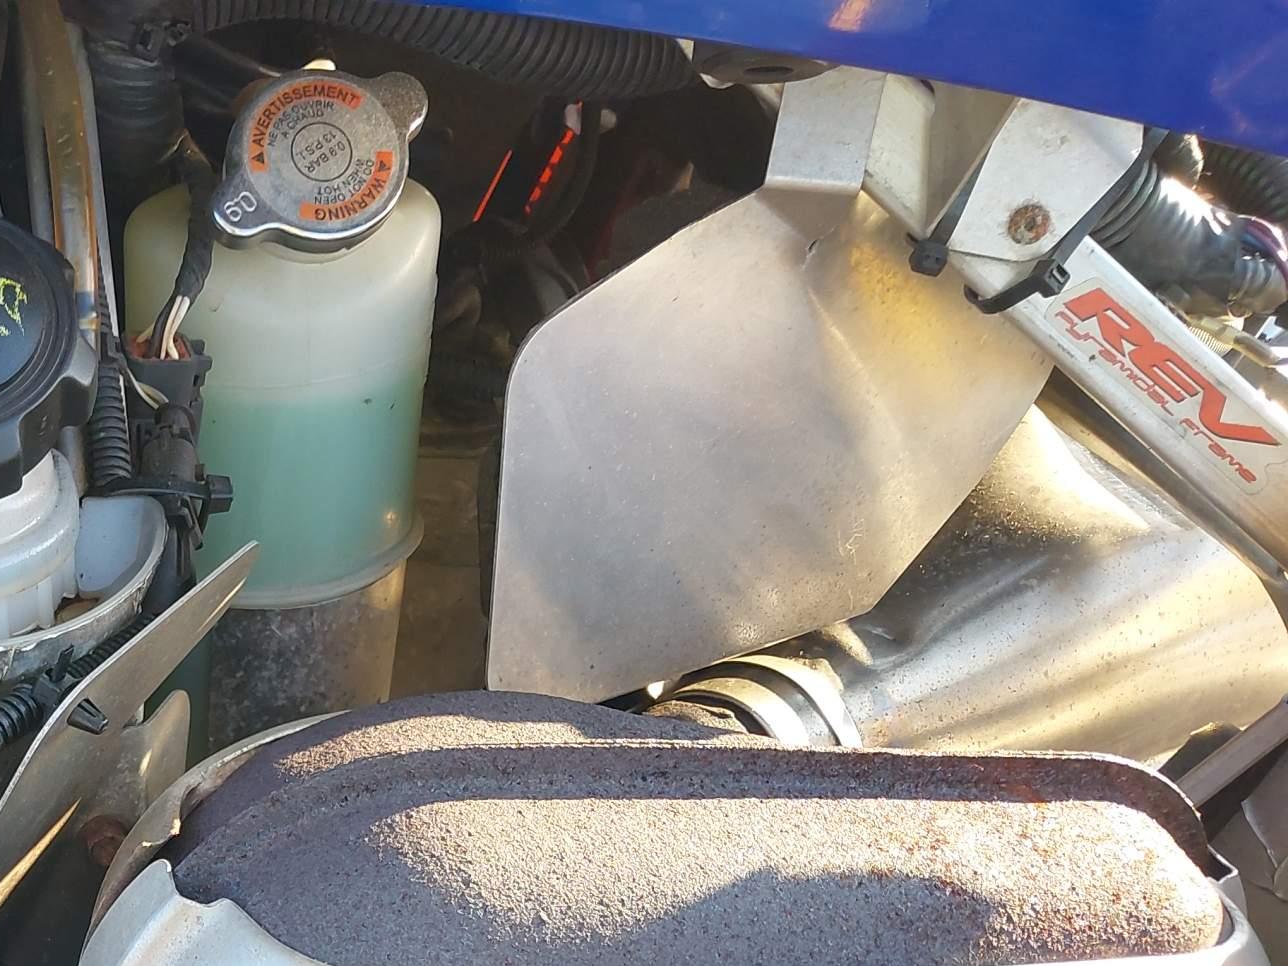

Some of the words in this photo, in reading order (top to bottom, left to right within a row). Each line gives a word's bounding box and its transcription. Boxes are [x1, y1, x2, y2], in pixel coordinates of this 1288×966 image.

[252, 84, 360, 147] AVERTISSEMENT
[286, 107, 325, 131] CHAUD
[323, 131, 337, 144] 13
[304, 152, 330, 173] BAR
[342, 158, 365, 189] WHEN
[362, 159, 375, 177] DO
[317, 183, 342, 196] HOT
[348, 175, 368, 198] NOT
[314, 192, 347, 205] OPEN
[314, 176, 388, 221] WARNING
[1063, 287, 1282, 446] REV
